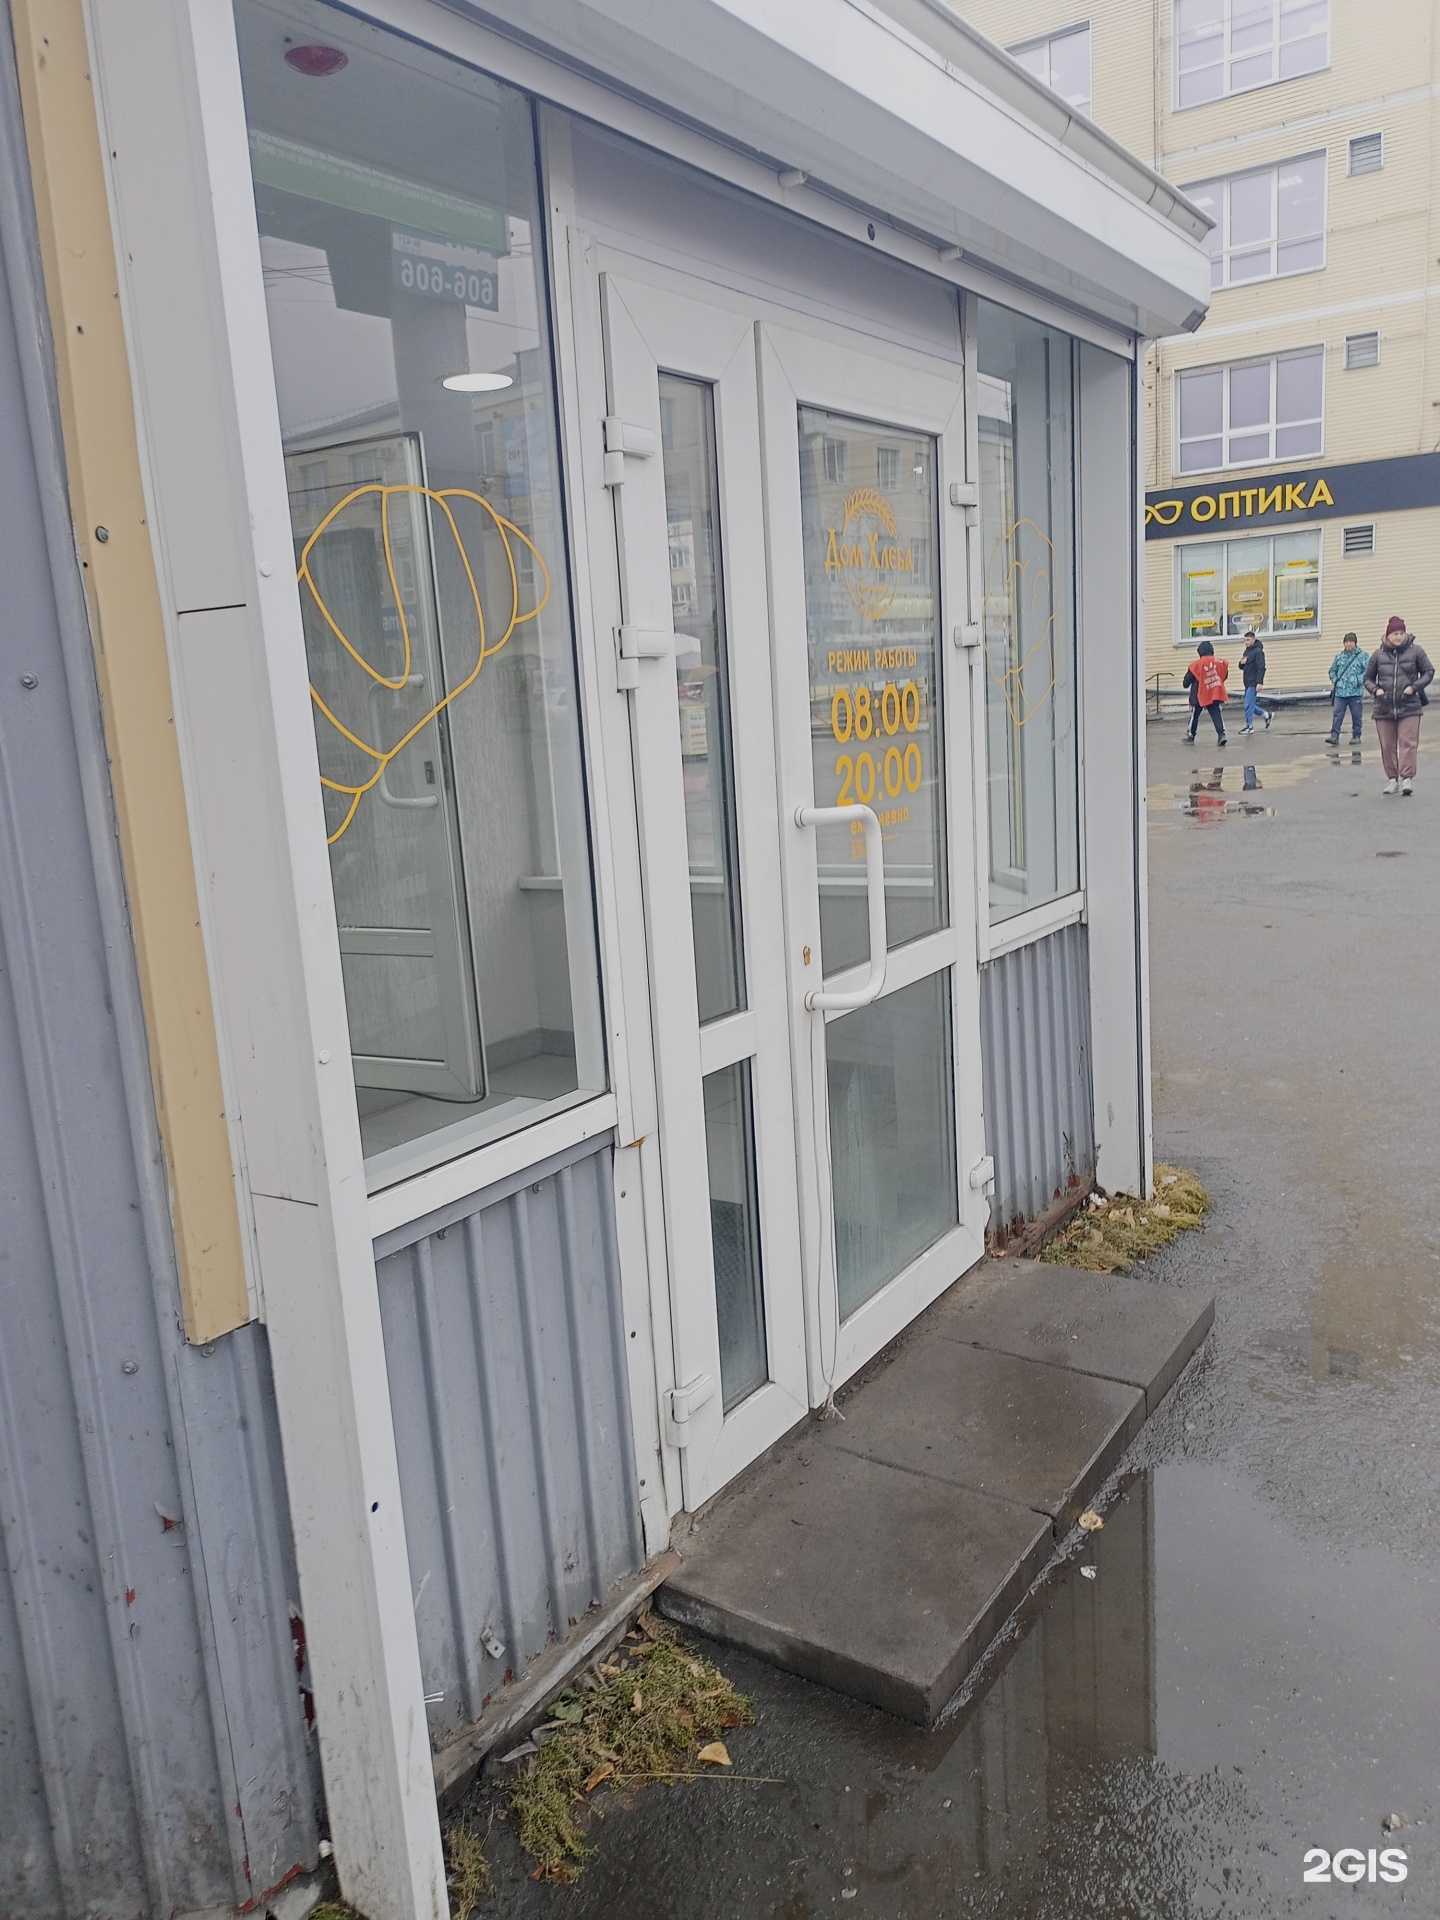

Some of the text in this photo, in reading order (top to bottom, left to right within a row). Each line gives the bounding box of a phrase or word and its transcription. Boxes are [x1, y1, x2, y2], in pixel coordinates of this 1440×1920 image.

[1190, 479, 1335, 522] ОПТИКА
[828, 647, 917, 673] РЕЖИМ РАБОТЫ
[831, 681, 919, 743] 08:00
[834, 743, 921, 808] 20:00
